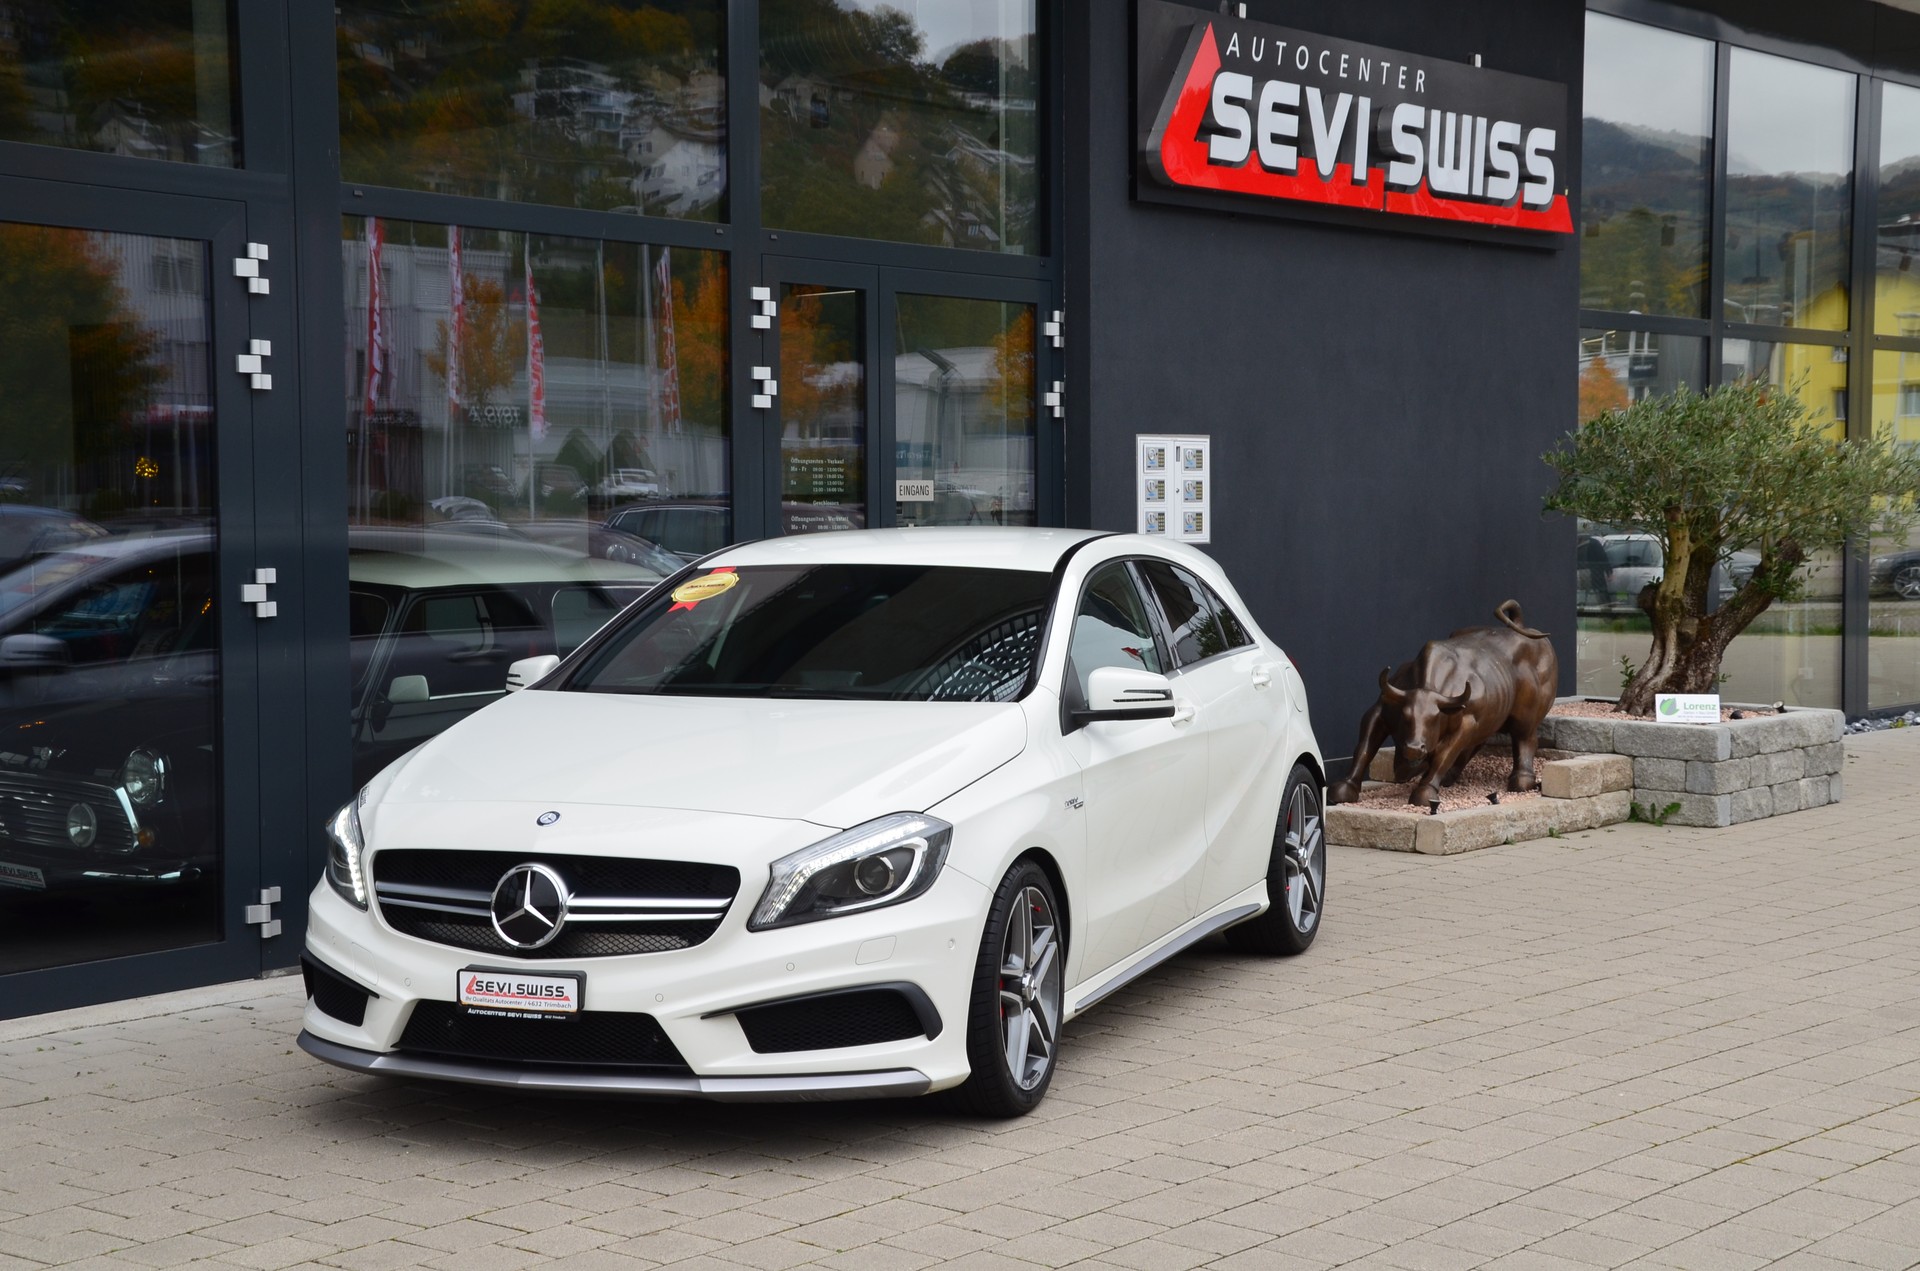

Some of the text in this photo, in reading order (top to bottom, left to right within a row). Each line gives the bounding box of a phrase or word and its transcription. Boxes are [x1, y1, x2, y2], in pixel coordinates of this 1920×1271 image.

[1226, 32, 1425, 93] AUTOCENTER
[1209, 71, 1556, 205] SEVI SWISS
[899, 484, 930, 496] EINGANG
[1683, 702, 1717, 710] Lorenz
[475, 981, 565, 998] SEVI SWISS
[495, 998, 523, 1006] Autocenter
